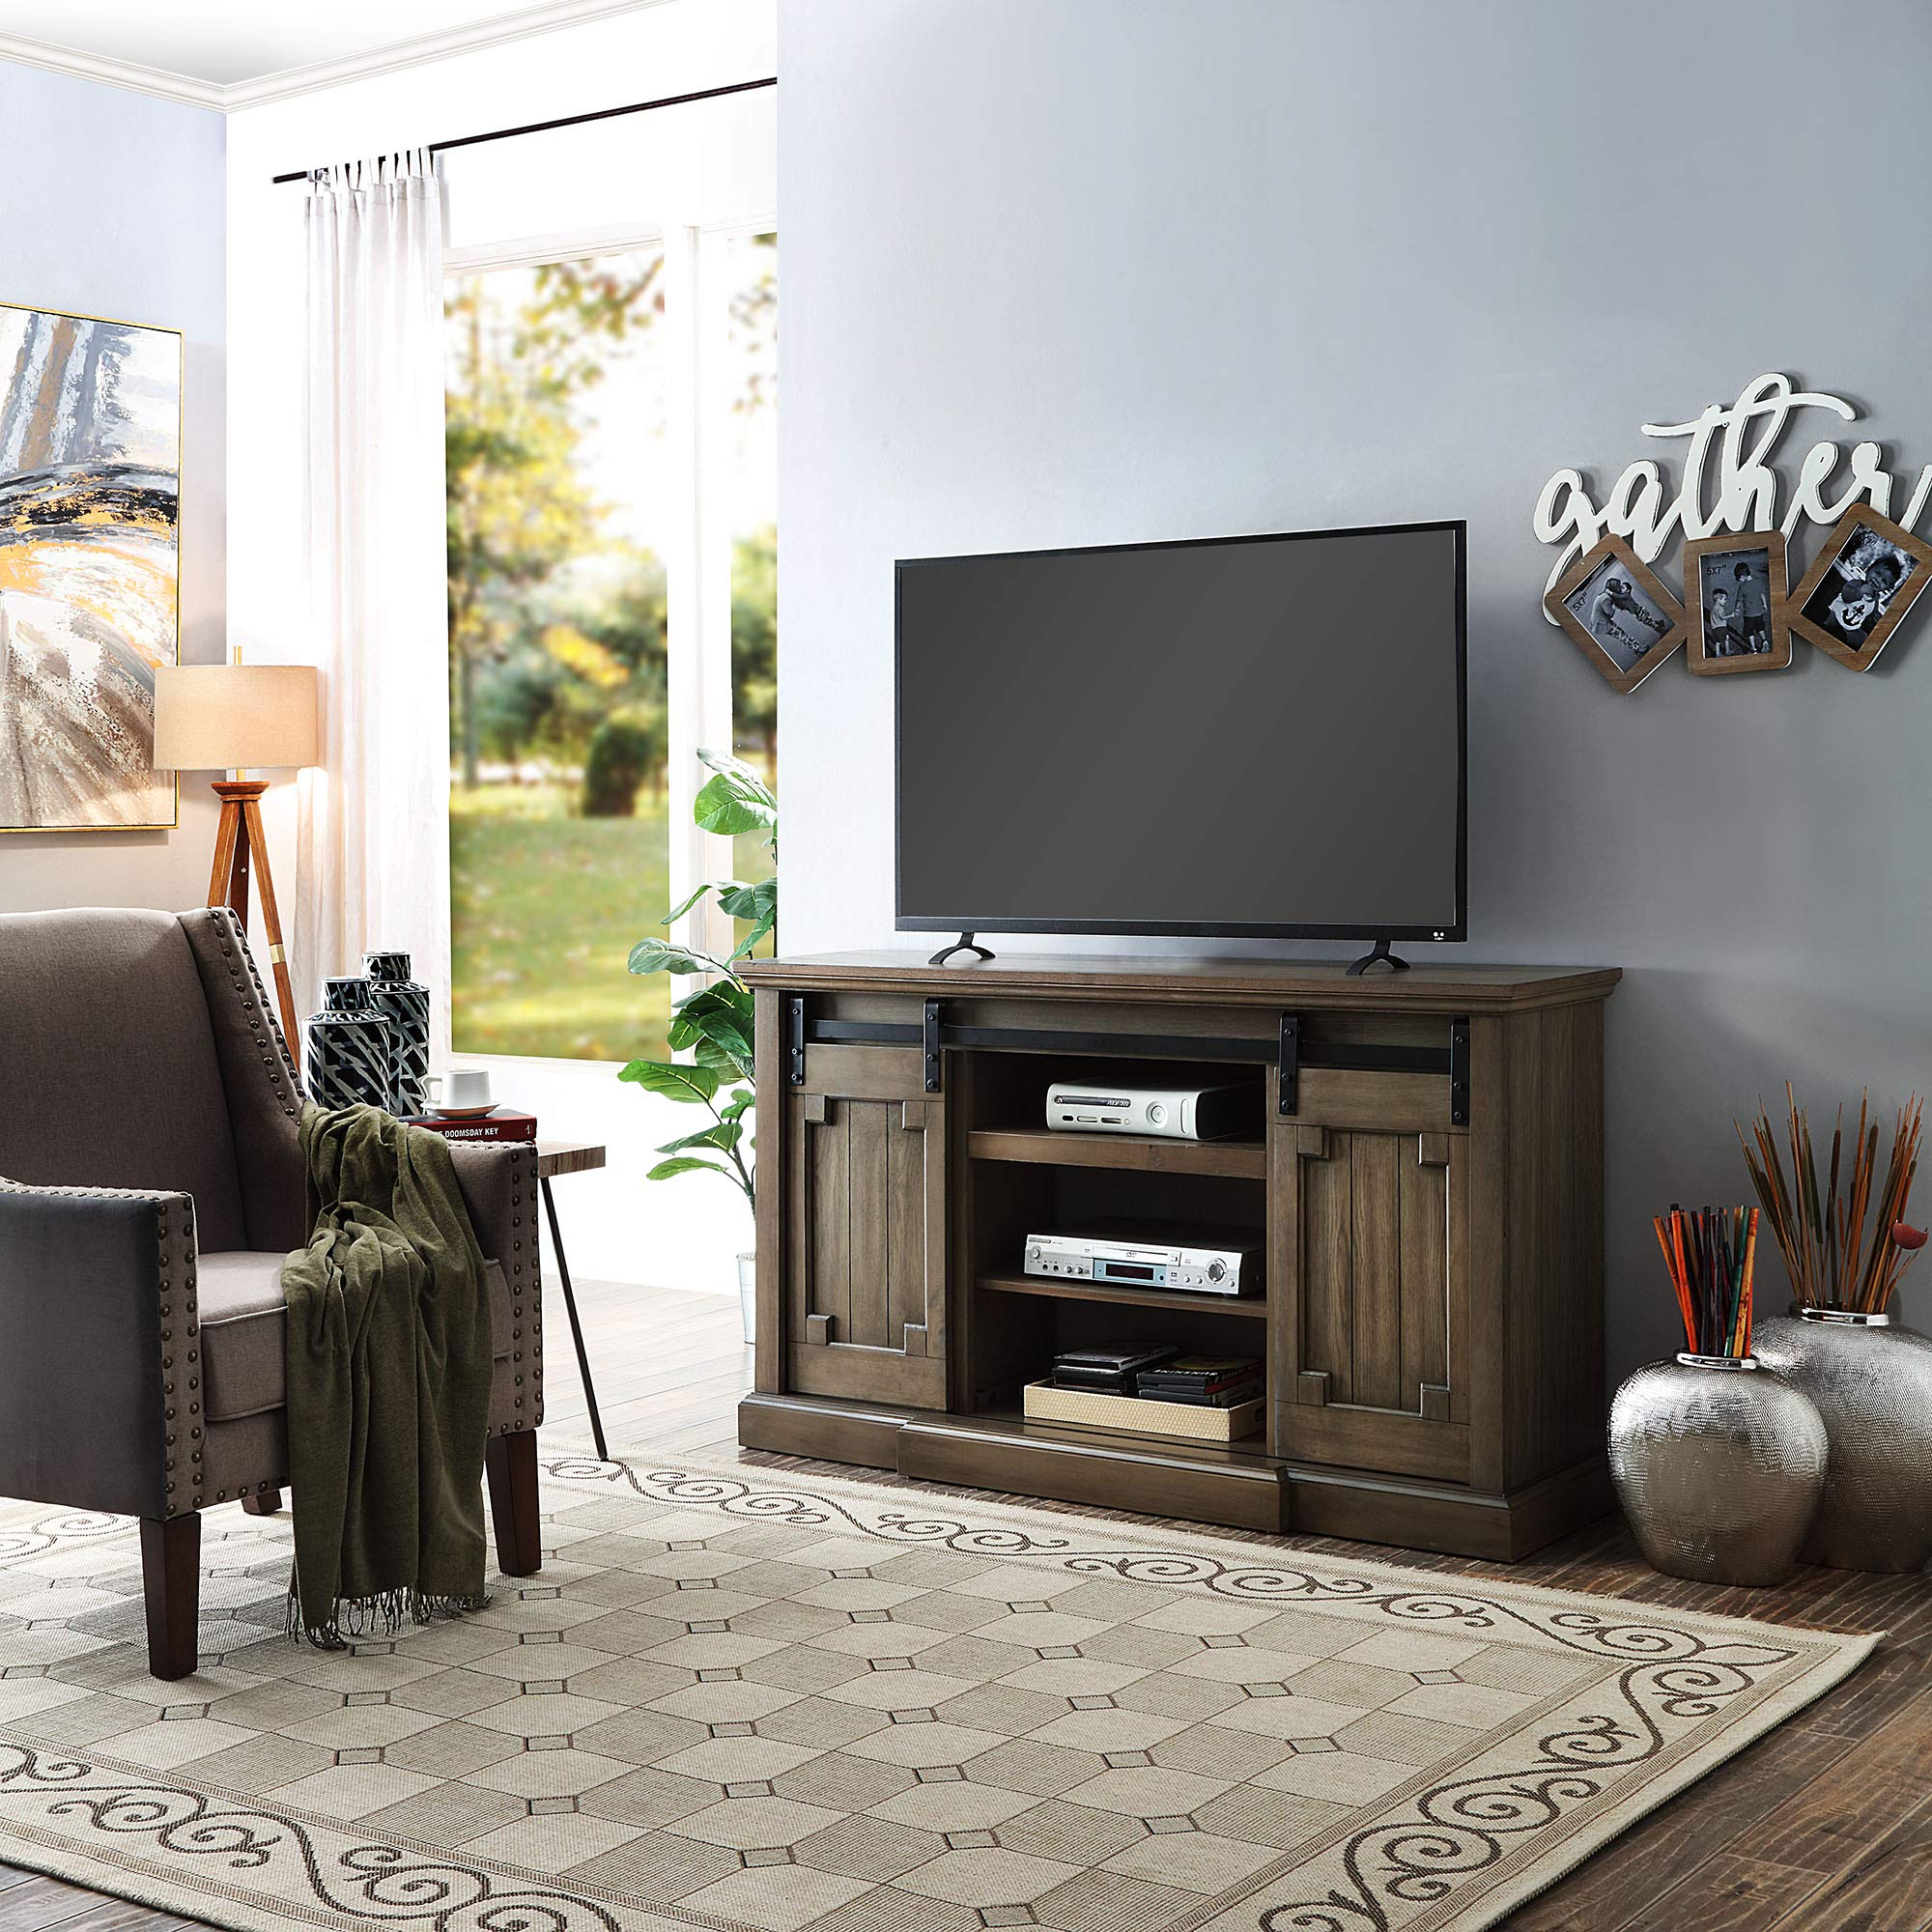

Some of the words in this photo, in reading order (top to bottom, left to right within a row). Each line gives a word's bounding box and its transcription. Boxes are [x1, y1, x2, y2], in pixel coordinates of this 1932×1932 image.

[1533, 371, 1932, 626] gather
[444, 1128, 484, 1138] DOOMSDAY
[484, 1127, 498, 1136] KEY
